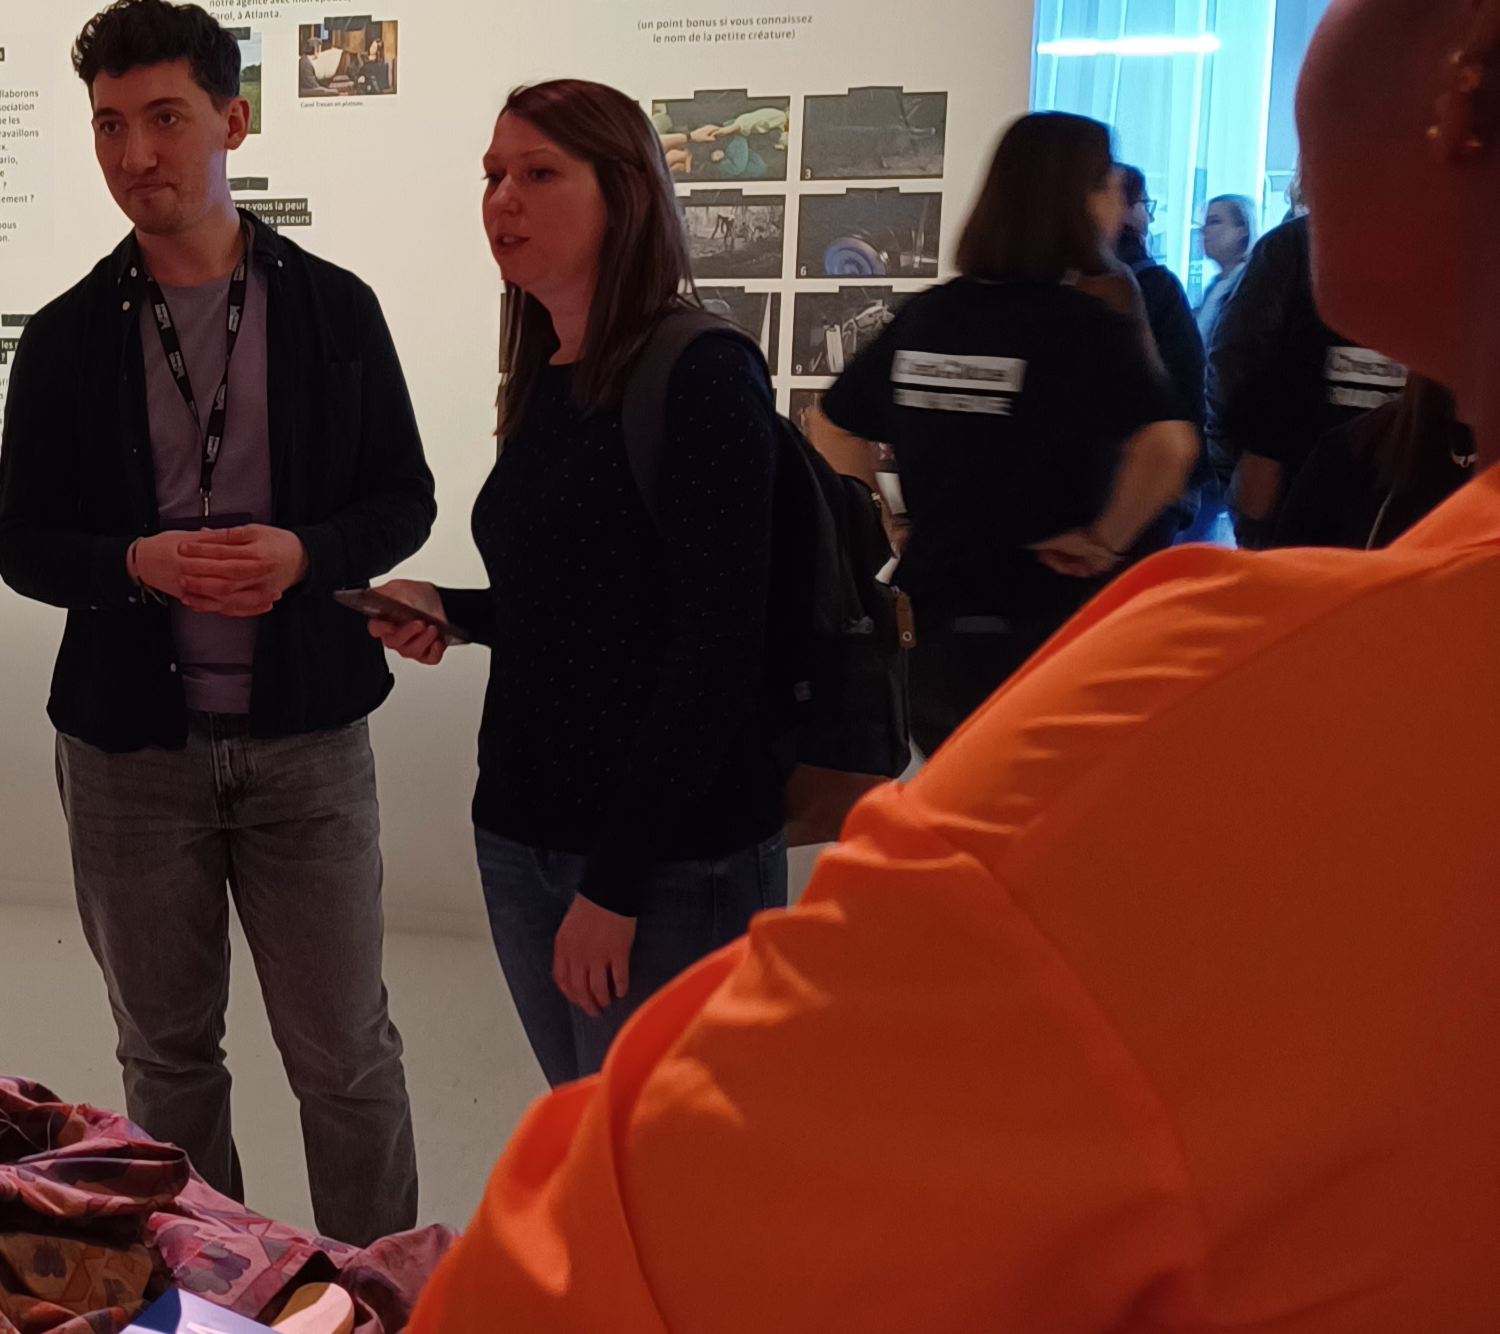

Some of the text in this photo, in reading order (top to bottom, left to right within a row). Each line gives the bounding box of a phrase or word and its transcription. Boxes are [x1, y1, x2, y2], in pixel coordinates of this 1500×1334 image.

[637, 21, 654, 29] (un
[656, 20, 683, 30] point
[685, 19, 717, 28] bonus
[729, 18, 754, 26] vous
[755, 15, 813, 25] connaissez
[664, 35, 686, 43] nom
[714, 32, 746, 42] petite
[748, 30, 796, 40] créature)
[804, 169, 811, 179] 3
[285, 202, 306, 211] peur
[277, 215, 310, 223] acteurs
[800, 266, 807, 276] 6
[795, 364, 802, 374] 9
